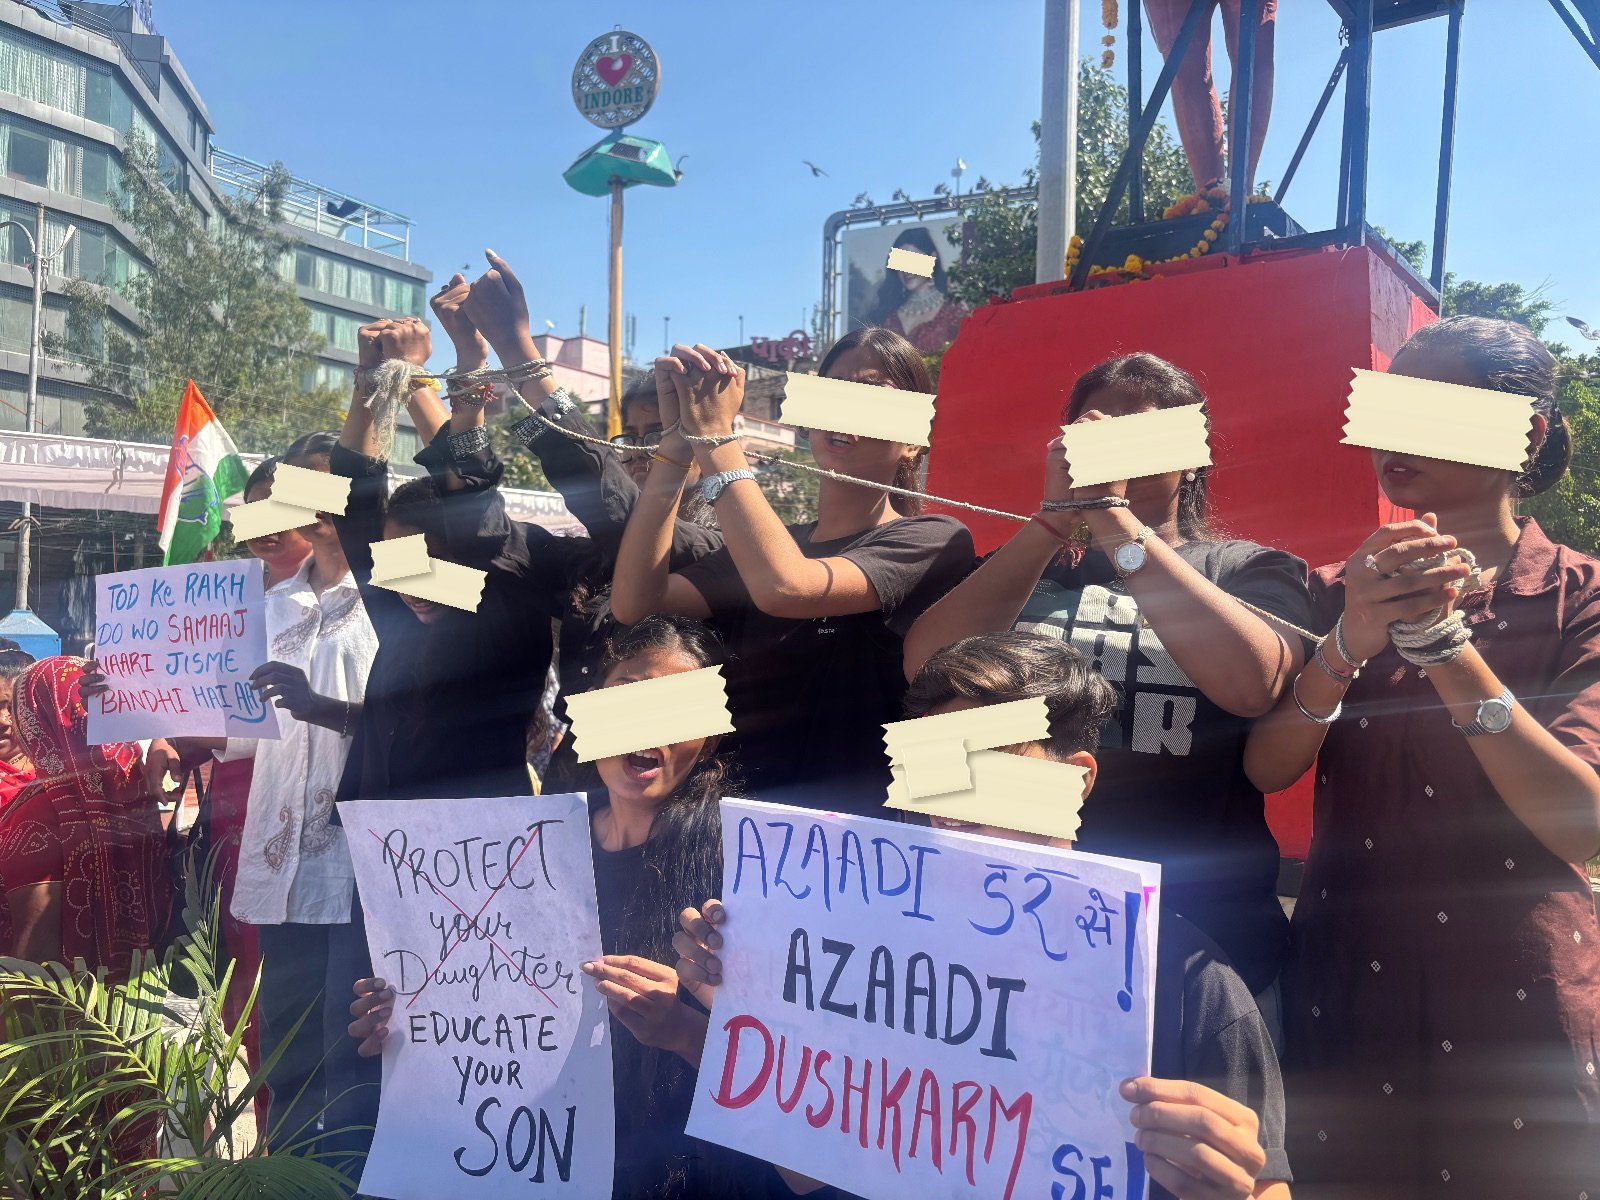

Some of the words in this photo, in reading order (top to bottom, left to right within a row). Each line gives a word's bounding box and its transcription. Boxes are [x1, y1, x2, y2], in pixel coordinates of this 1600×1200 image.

[609, 35, 620, 53] I
[583, 86, 645, 110] INDORE
[108, 583, 139, 612] TOD
[185, 572, 246, 607] RAKH
[97, 622, 123, 646] DO
[131, 618, 159, 641] WO
[167, 608, 248, 646] SAMAAJ
[95, 652, 155, 679] NAARI
[165, 649, 239, 676] JISME
[95, 687, 190, 715] BANDHI
[192, 684, 232, 709] HAI
[382, 819, 565, 898] PROTECT
[733, 816, 942, 922] AZAADI
[968, 863, 1081, 962] डर
[428, 911, 513, 962] your
[383, 942, 578, 1001] Daughter
[782, 927, 1028, 1062] AZAADI
[409, 1010, 559, 1053] EDUCATE
[451, 1055, 524, 1105] YOUR
[708, 1014, 1034, 1200] DUSHKARM
[453, 1096, 577, 1184] SON
